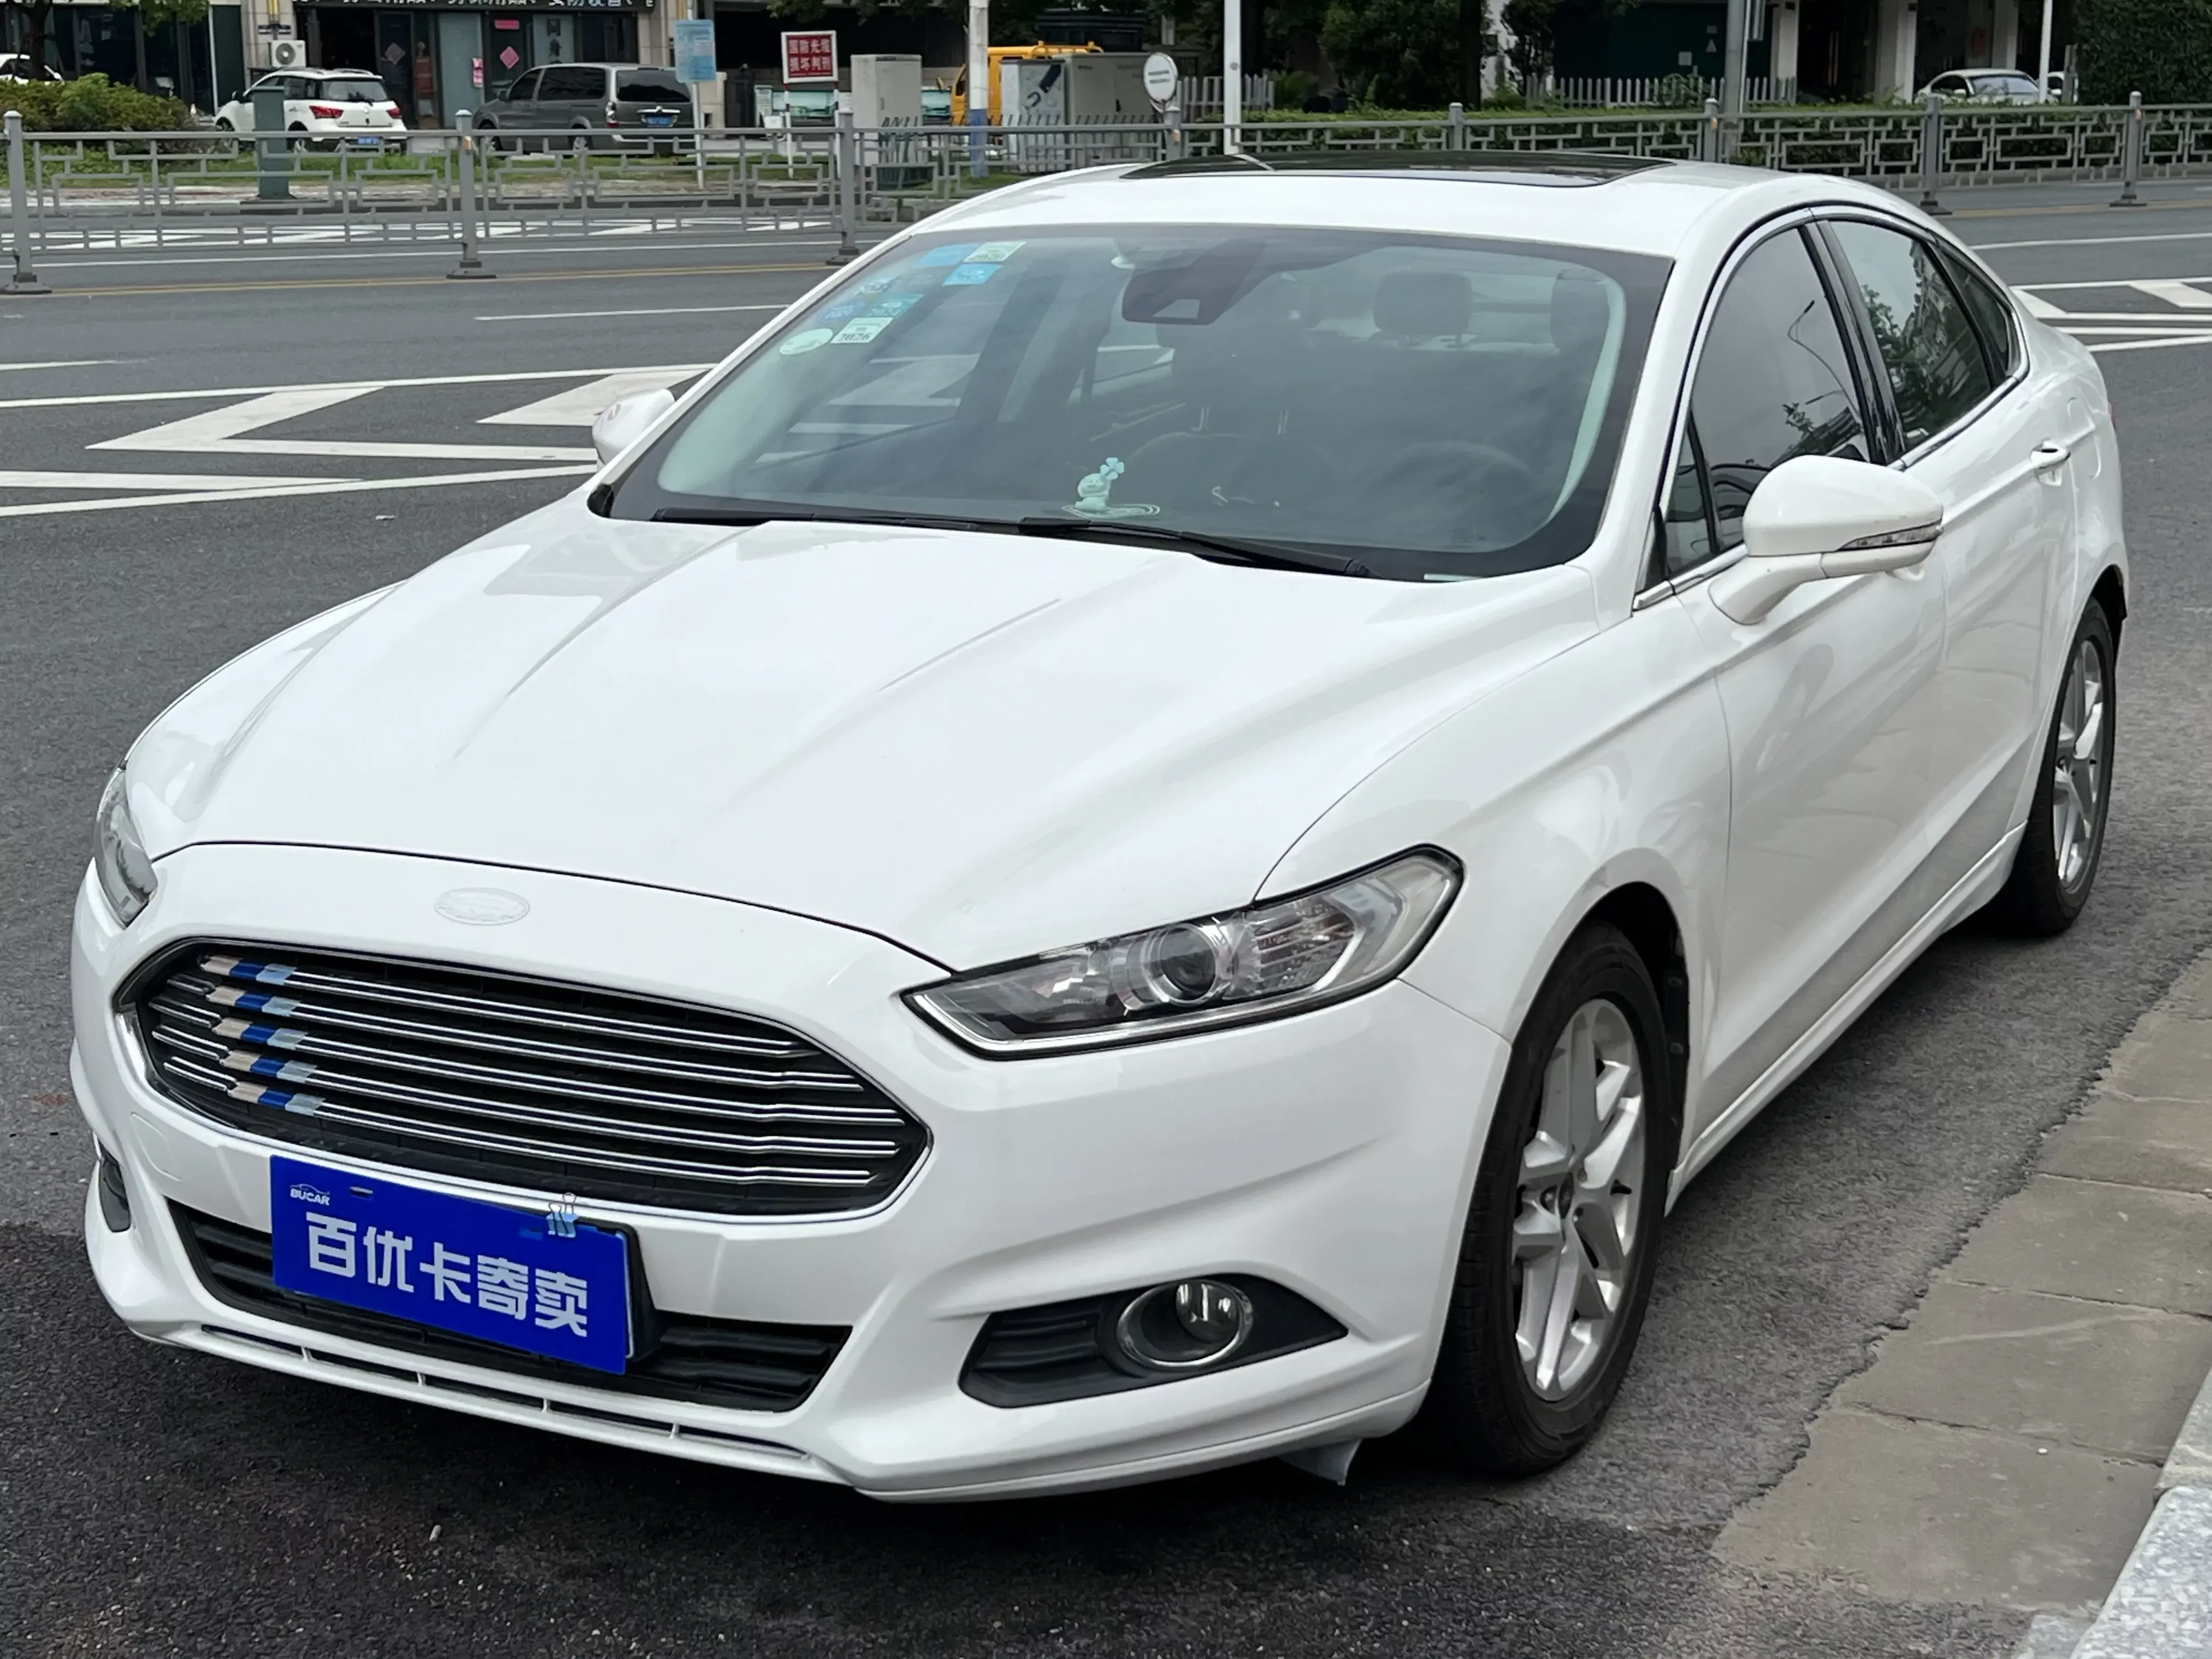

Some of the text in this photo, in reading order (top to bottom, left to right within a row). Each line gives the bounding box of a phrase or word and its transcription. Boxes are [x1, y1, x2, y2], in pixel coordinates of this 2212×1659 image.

[290, 1188, 330, 1206] BUCAR
[306, 1211, 587, 1338] 百优卡寄卖
